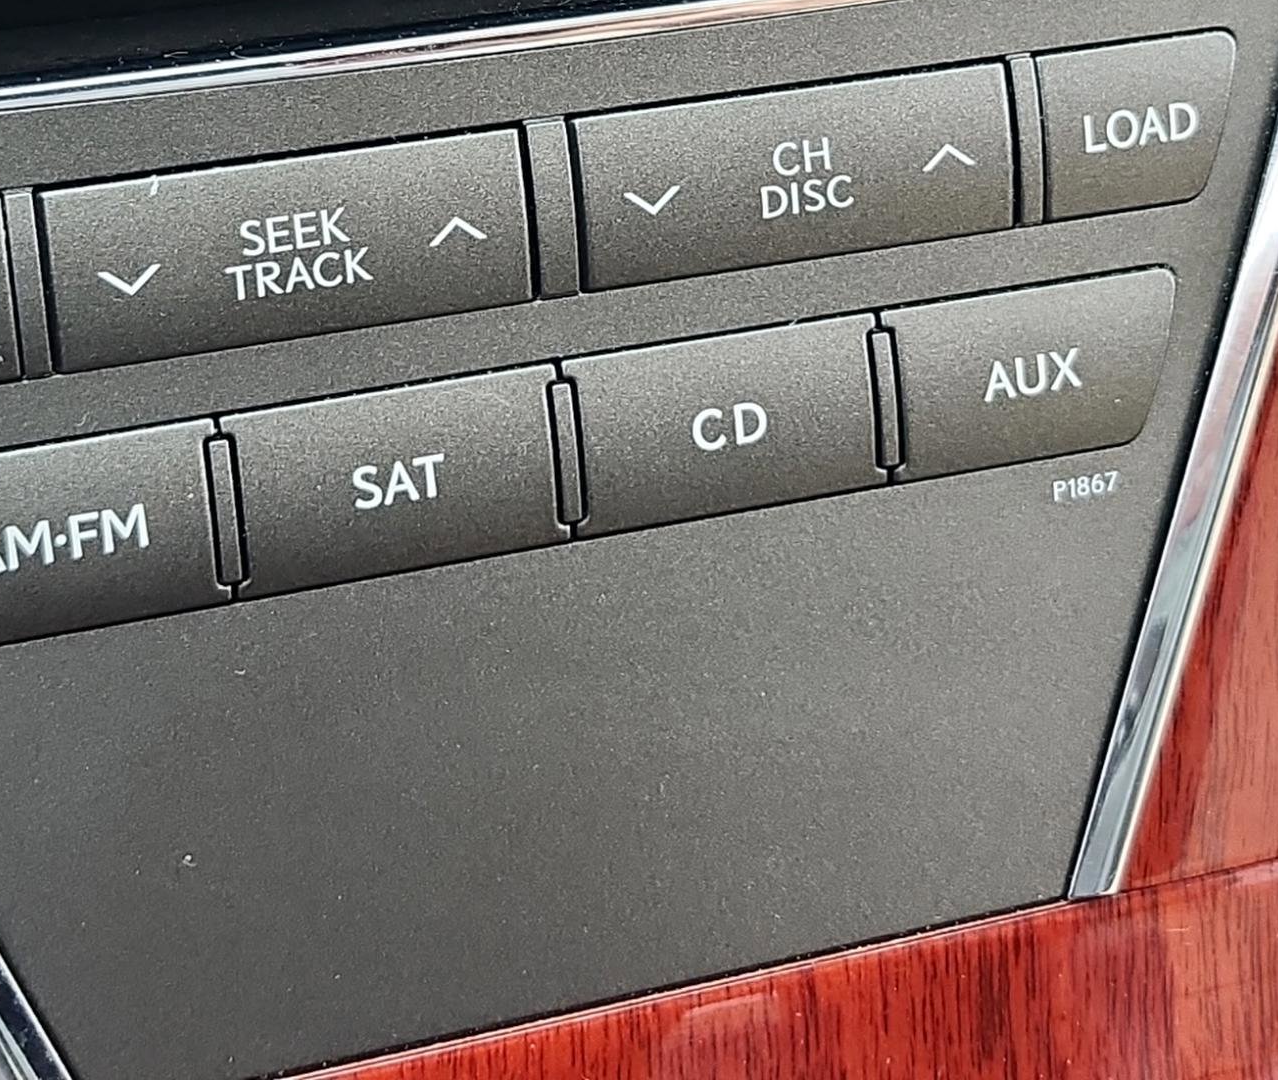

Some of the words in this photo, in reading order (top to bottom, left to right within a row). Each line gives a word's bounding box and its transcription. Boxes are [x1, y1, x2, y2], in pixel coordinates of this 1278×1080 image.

[1082, 101, 1198, 153] LOAD
[772, 136, 833, 177] CH
[759, 174, 855, 219] DISC
[239, 206, 352, 257] SEEK
[224, 245, 374, 302] TRACK
[983, 347, 1083, 402] AUX
[691, 402, 768, 452] CD
[351, 452, 445, 510] SAT
[1052, 470, 1120, 502] P1867
